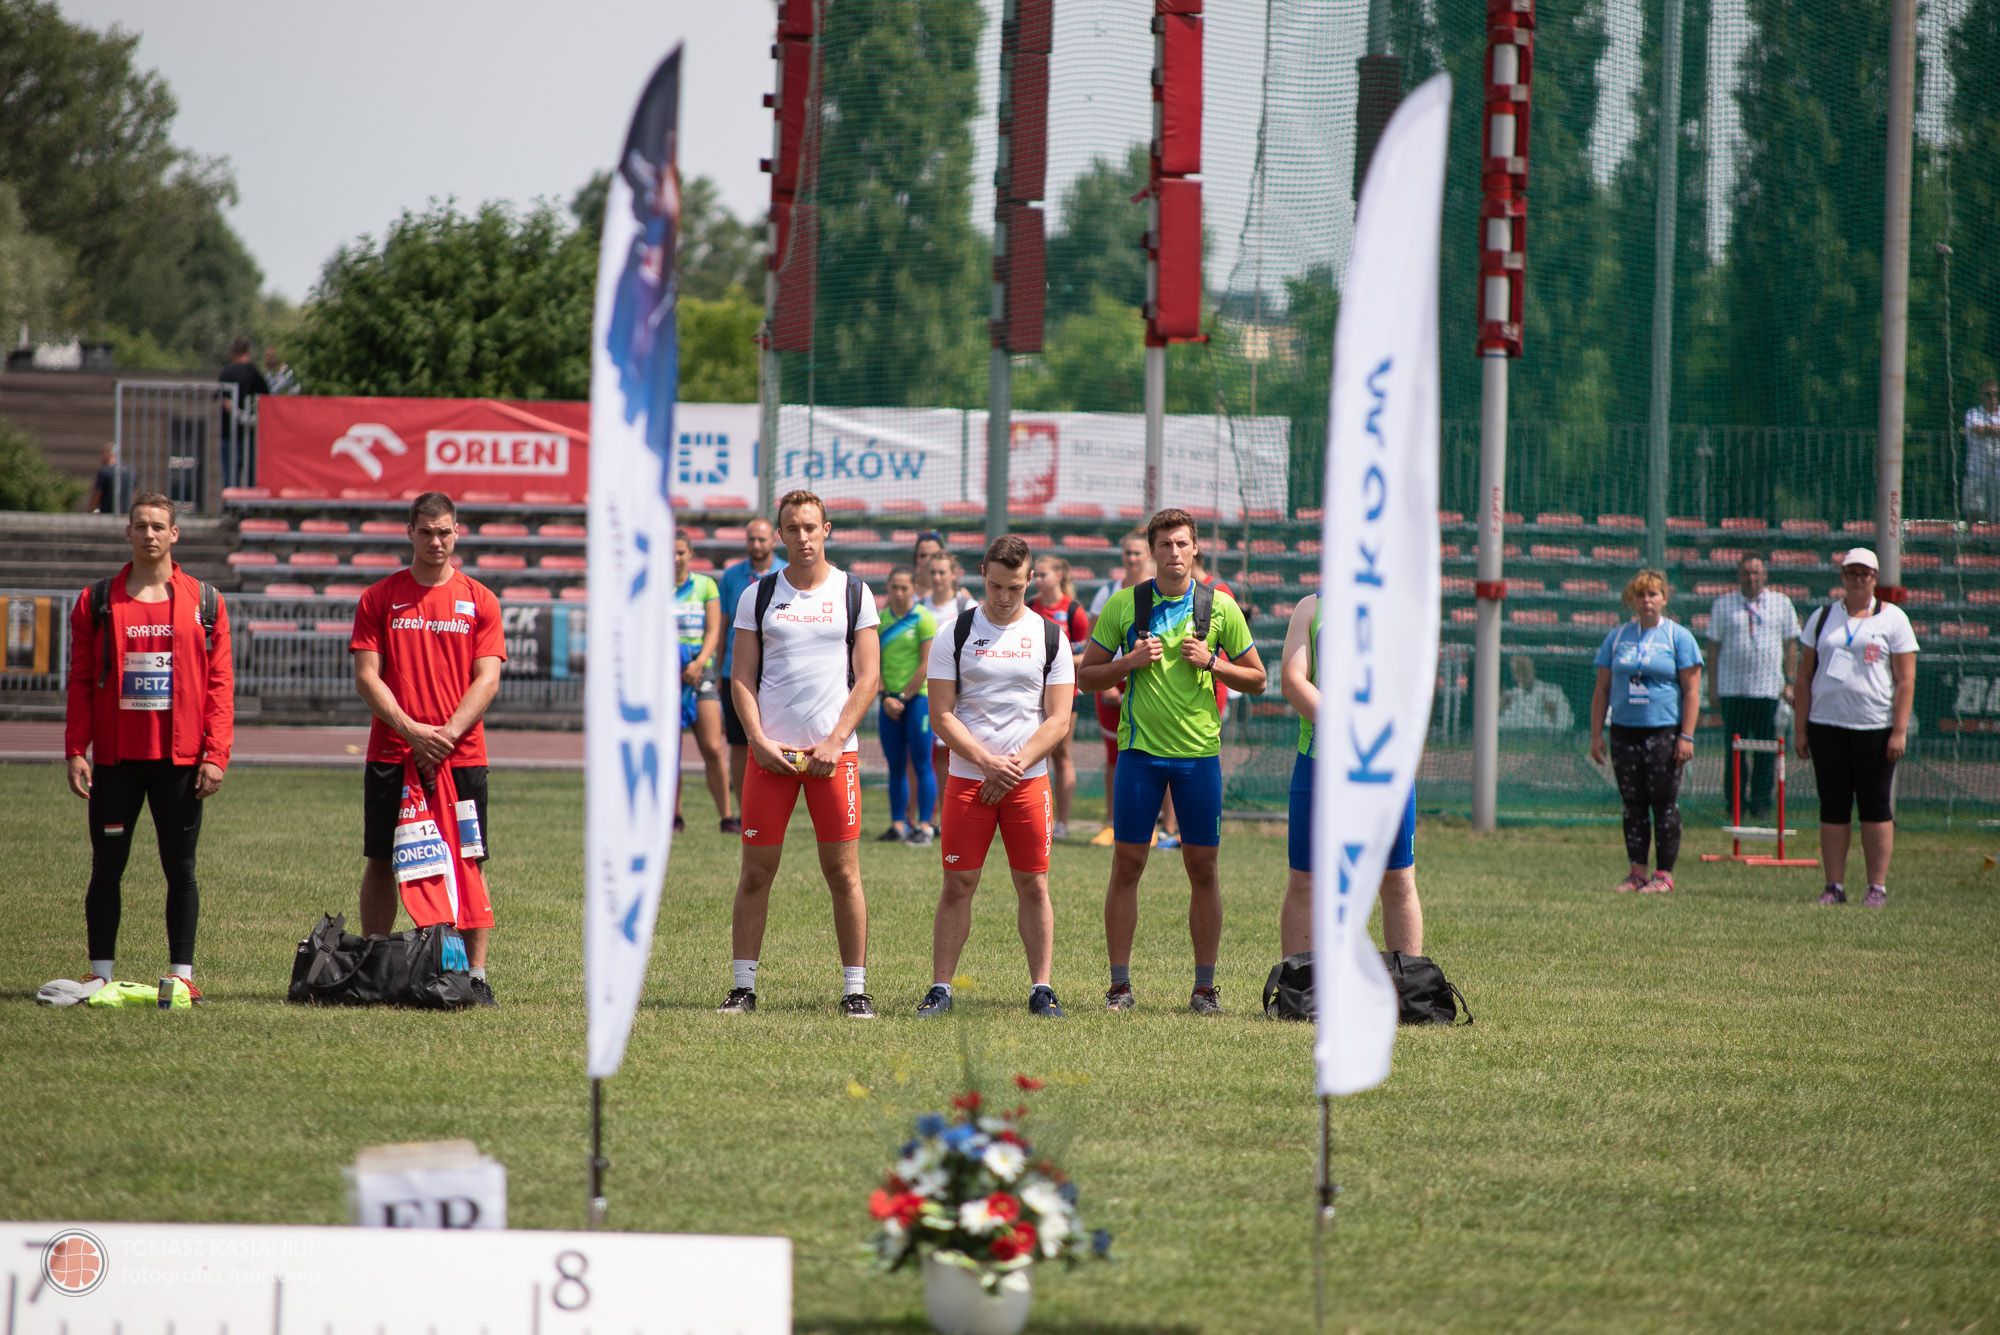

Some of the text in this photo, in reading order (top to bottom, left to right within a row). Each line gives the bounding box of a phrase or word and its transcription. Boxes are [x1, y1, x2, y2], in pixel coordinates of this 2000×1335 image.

[436, 438, 558, 465] ORLEN
[775, 602, 791, 611] 4F
[392, 615, 470, 634] czech republic
[776, 613, 832, 623] POLSKA
[973, 638, 991, 647] 4F
[974, 649, 1032, 659] POLSKA
[155, 655, 173, 668] 34
[134, 676, 170, 691] PETZ
[845, 761, 857, 826] POLSKA
[419, 823, 438, 837] 12
[1043, 790, 1053, 857] POLSKA
[744, 828, 759, 838] 4F
[392, 841, 447, 866] KONECNY
[944, 854, 960, 864] 4F
[552, 1250, 590, 1311] 8
